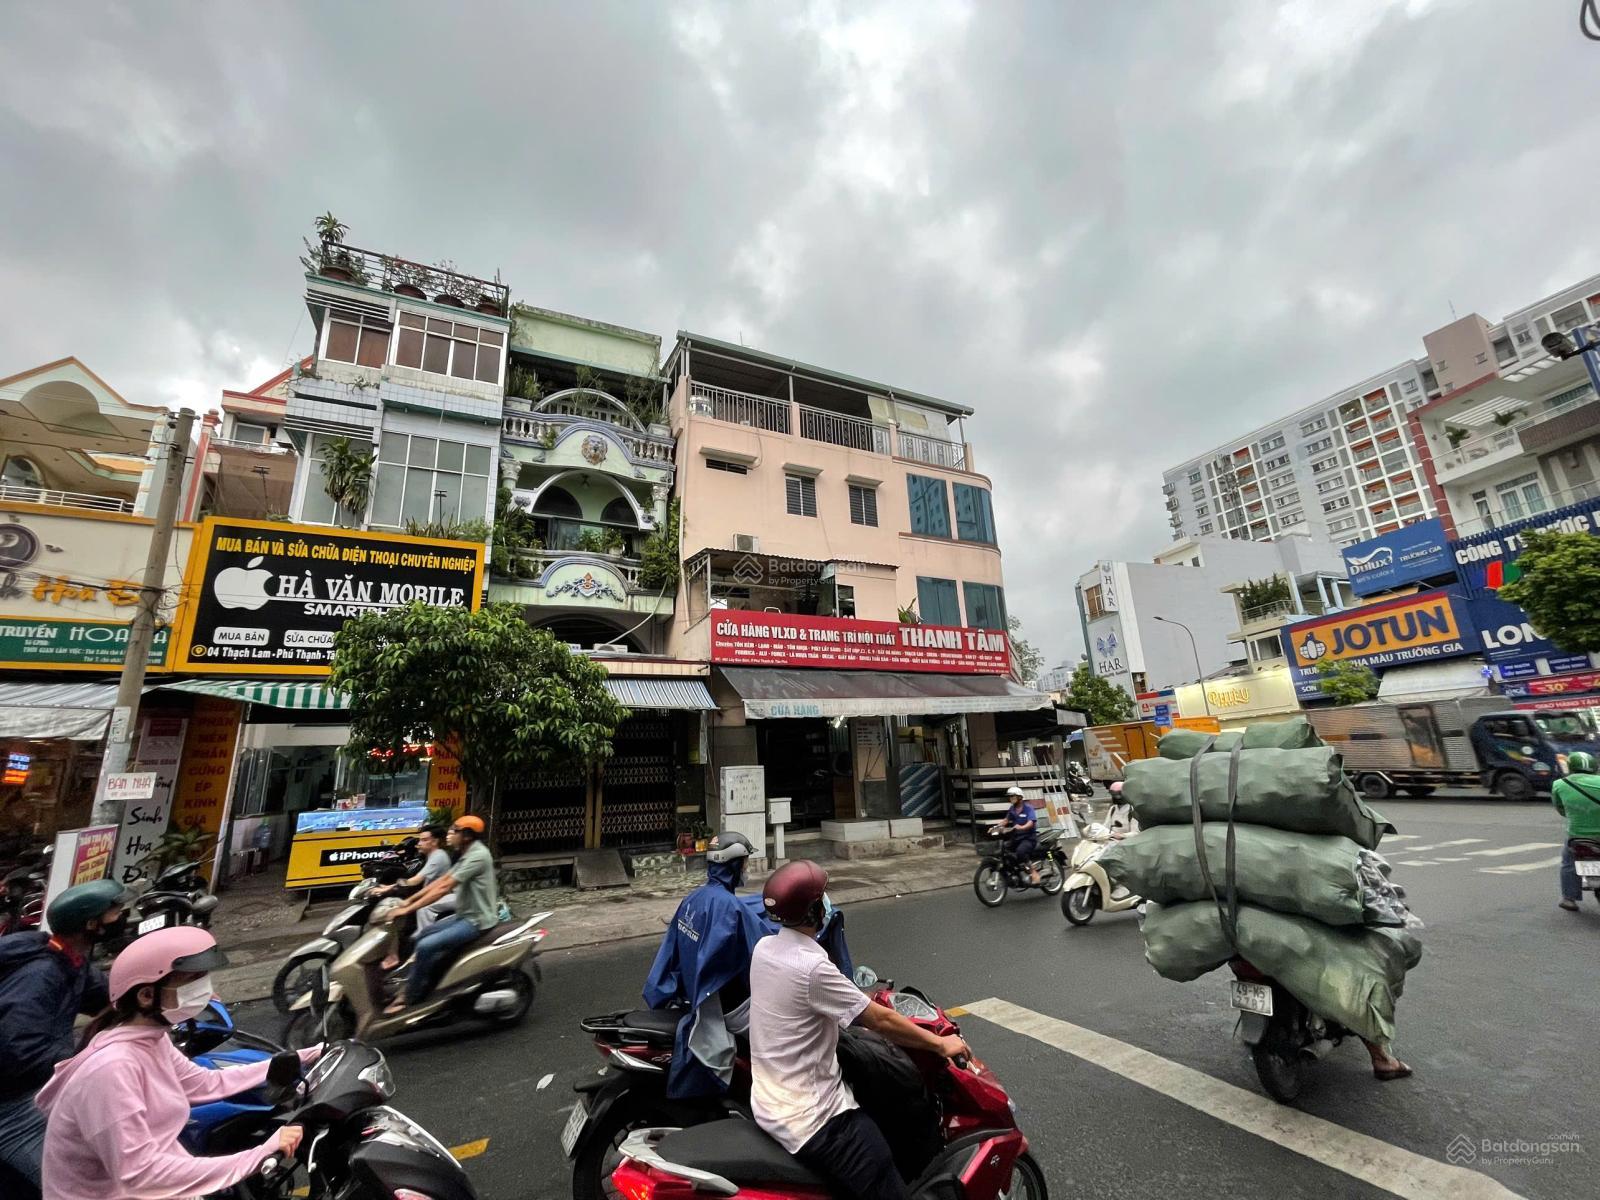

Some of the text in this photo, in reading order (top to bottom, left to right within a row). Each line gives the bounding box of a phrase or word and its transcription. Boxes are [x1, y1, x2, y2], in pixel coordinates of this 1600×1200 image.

[216, 536, 475, 575] MUA BÁN VÀ SỬA CHỮA ĐIỆN THOẠI CHUYÊN NGHIỆP
[1455, 540, 1503, 565] CÔNG
[1349, 556, 1389, 576] Dulux
[276, 569, 465, 607] HÀ VĂN MOBILE
[70, 627, 129, 642] HOA
[218, 631, 265, 641] MUA BÁN
[286, 631, 334, 644] SỬA CHỮA
[716, 619, 739, 636] CỬA
[741, 621, 770, 638] HÀNG
[771, 626, 797, 639] VLXD
[799, 628, 807, 641] &
[808, 629, 840, 642] TRANG
[842, 629, 857, 643] TRÍ
[899, 627, 963, 650] THANH
[964, 629, 1005, 652] TÂM
[1332, 605, 1450, 655] JOTUN
[207, 646, 219, 657] 04
[222, 646, 248, 661] Thạch
[252, 648, 271, 659] Lam
[277, 648, 293, 660] Phú
[296, 649, 321, 662] Thạnh
[1370, 652, 1394, 665] MÀU
[1397, 645, 1440, 661] TRƯỜNG
[1442, 642, 1464, 654] GIA
[1099, 657, 1123, 674] HAR
[339, 850, 385, 861] iPhone
